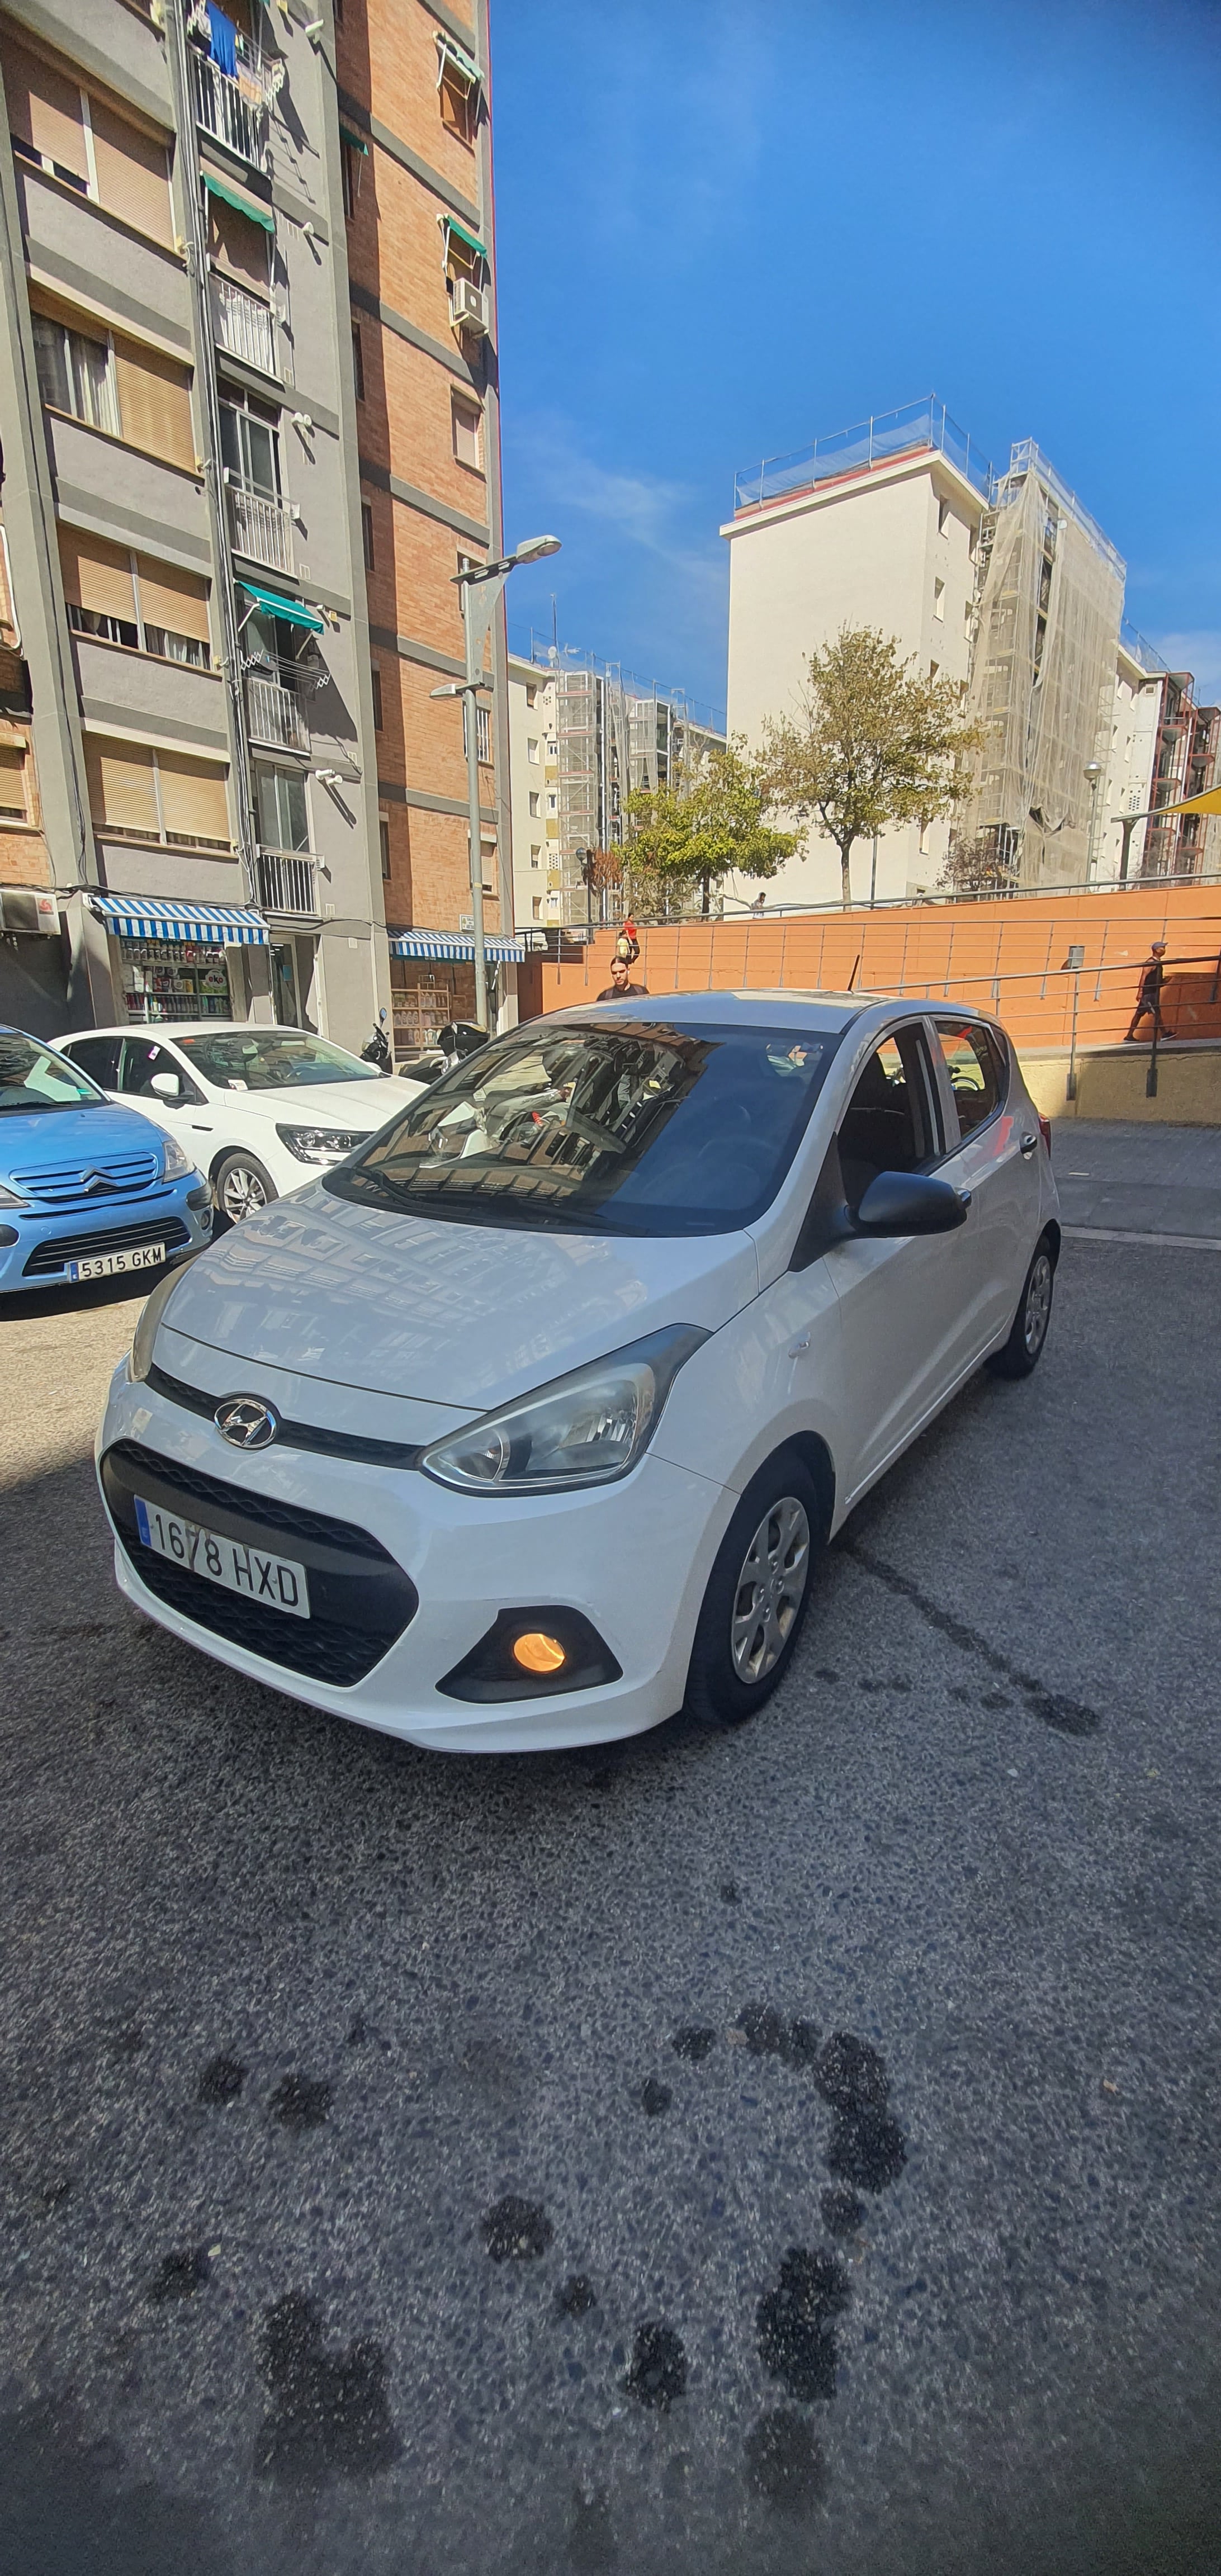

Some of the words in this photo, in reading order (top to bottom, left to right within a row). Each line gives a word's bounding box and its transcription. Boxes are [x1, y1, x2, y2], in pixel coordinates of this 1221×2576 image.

[209, 974, 224, 984] eko
[82, 1256, 126, 1277] 5315
[132, 1247, 162, 1267] GKM
[155, 1514, 223, 1577] 1678
[233, 1548, 299, 1607] HXD
